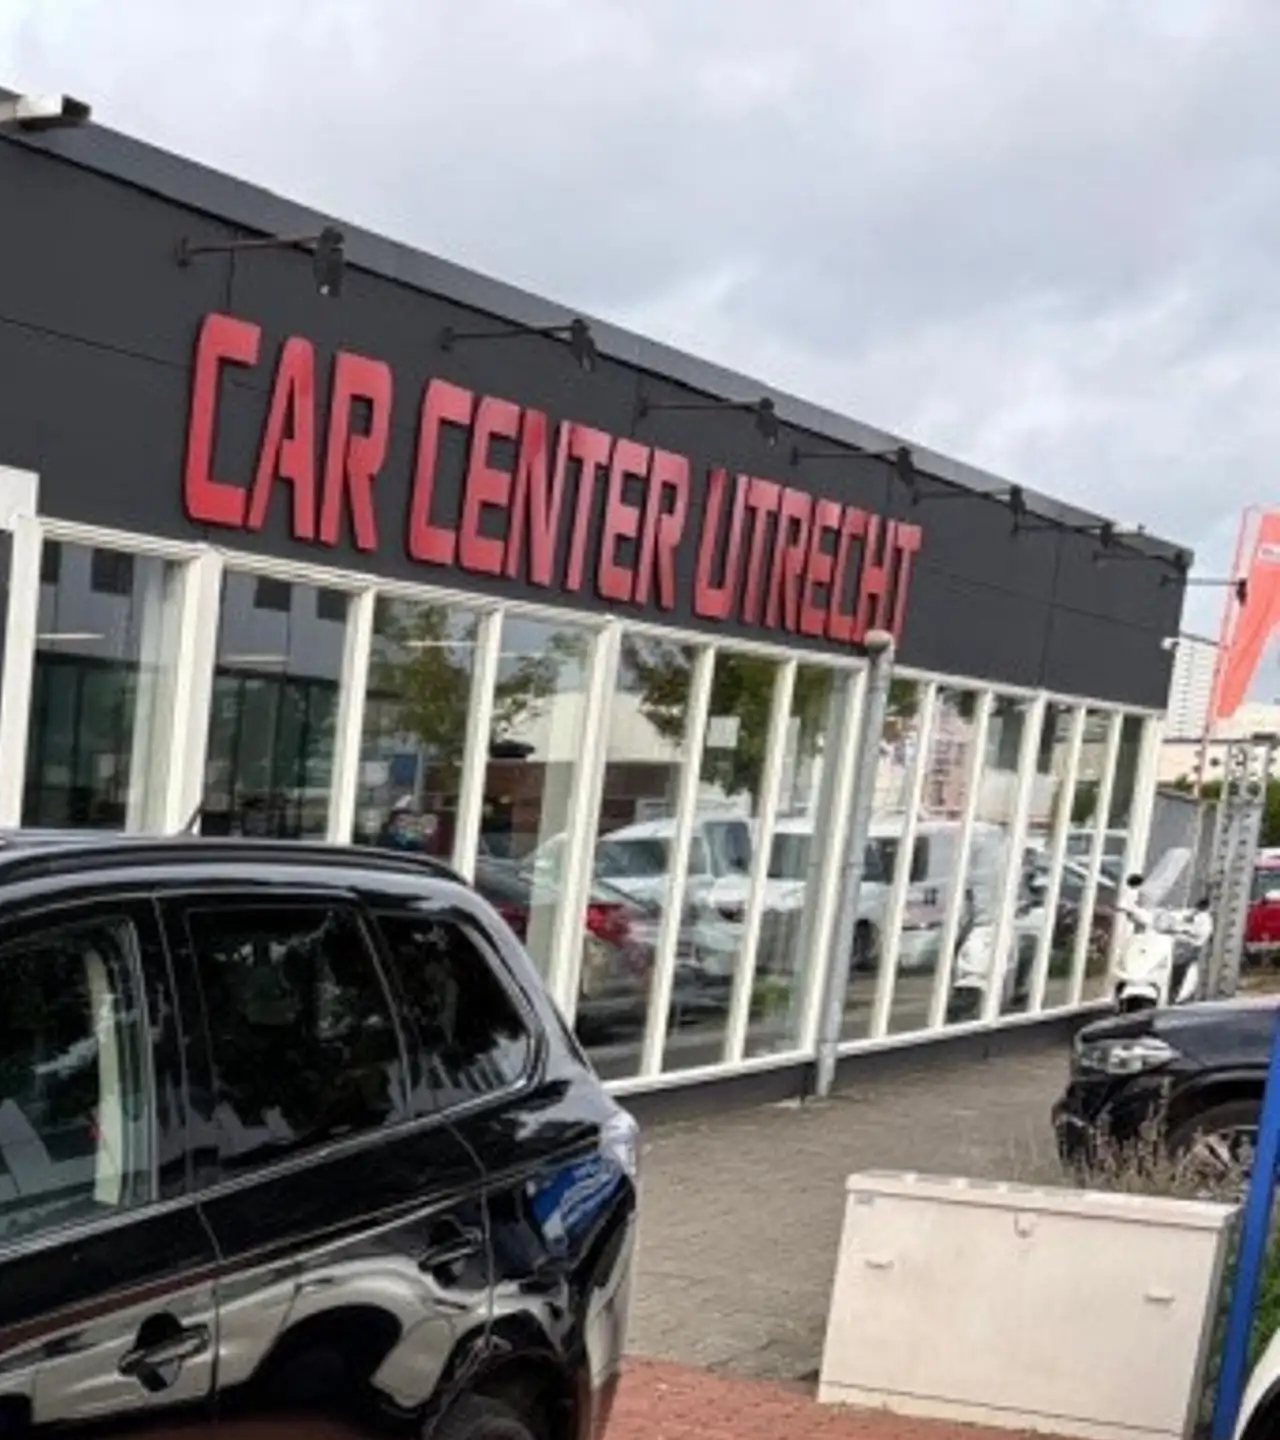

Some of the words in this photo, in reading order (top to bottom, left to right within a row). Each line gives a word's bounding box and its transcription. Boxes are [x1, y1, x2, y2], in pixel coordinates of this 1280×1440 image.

[183, 311, 394, 551] CAR
[408, 378, 690, 610] CENTER
[693, 467, 922, 642] UTRECHT
